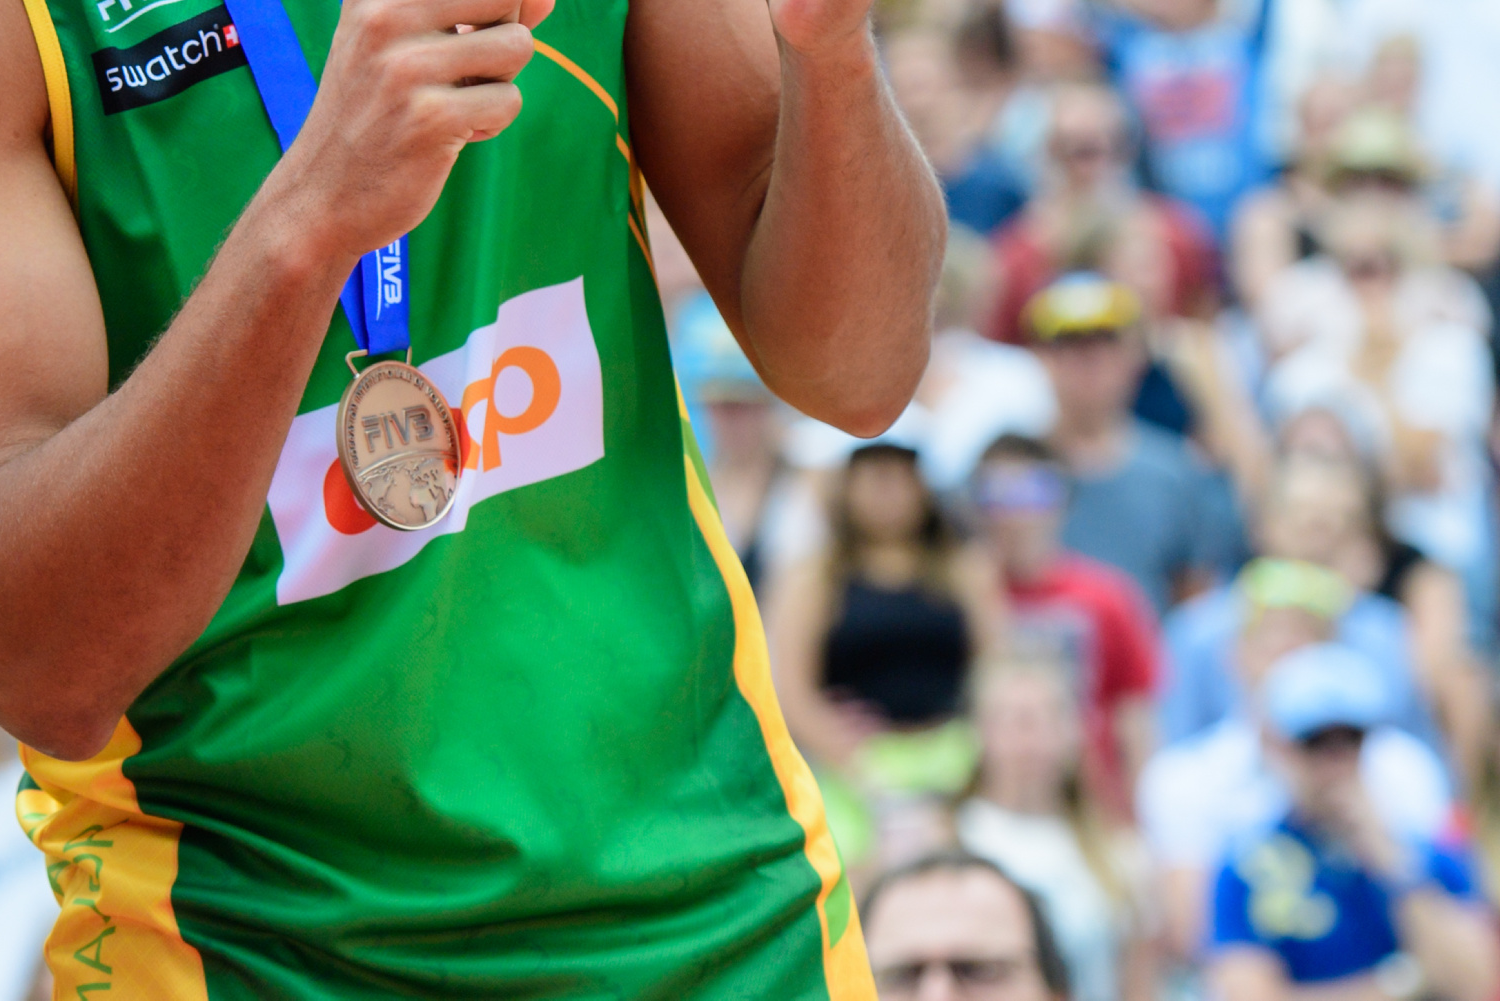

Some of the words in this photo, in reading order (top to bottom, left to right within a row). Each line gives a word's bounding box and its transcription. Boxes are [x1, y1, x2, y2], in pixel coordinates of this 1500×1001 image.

[105, 29, 222, 92] swatch
[381, 239, 402, 304] FIVB
[361, 404, 434, 453] FIVB
